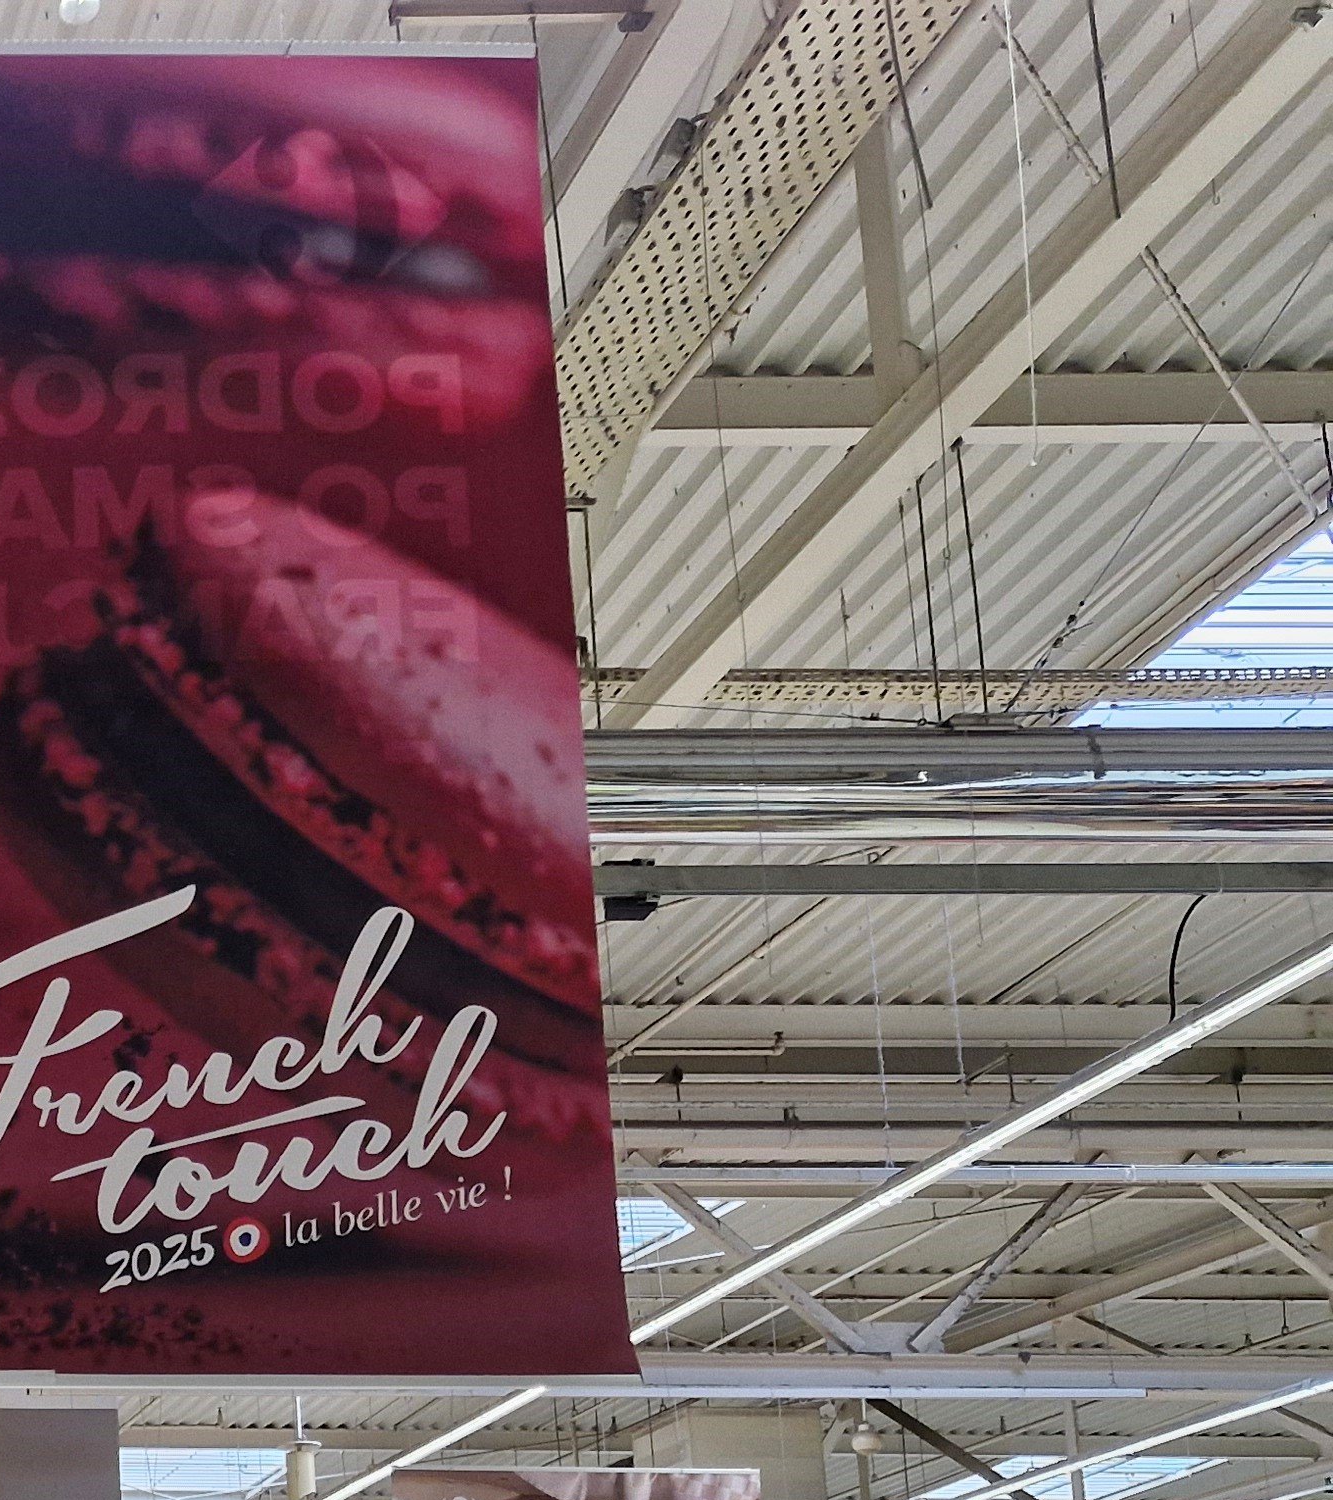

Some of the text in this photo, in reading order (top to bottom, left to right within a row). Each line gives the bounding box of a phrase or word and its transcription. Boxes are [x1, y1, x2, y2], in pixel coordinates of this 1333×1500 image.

[50, 1005, 506, 1233] touch
[99, 1225, 217, 1293] 2025
[283, 1213, 320, 1248] la
[332, 1188, 423, 1237] belle
[434, 1174, 488, 1214] vie
